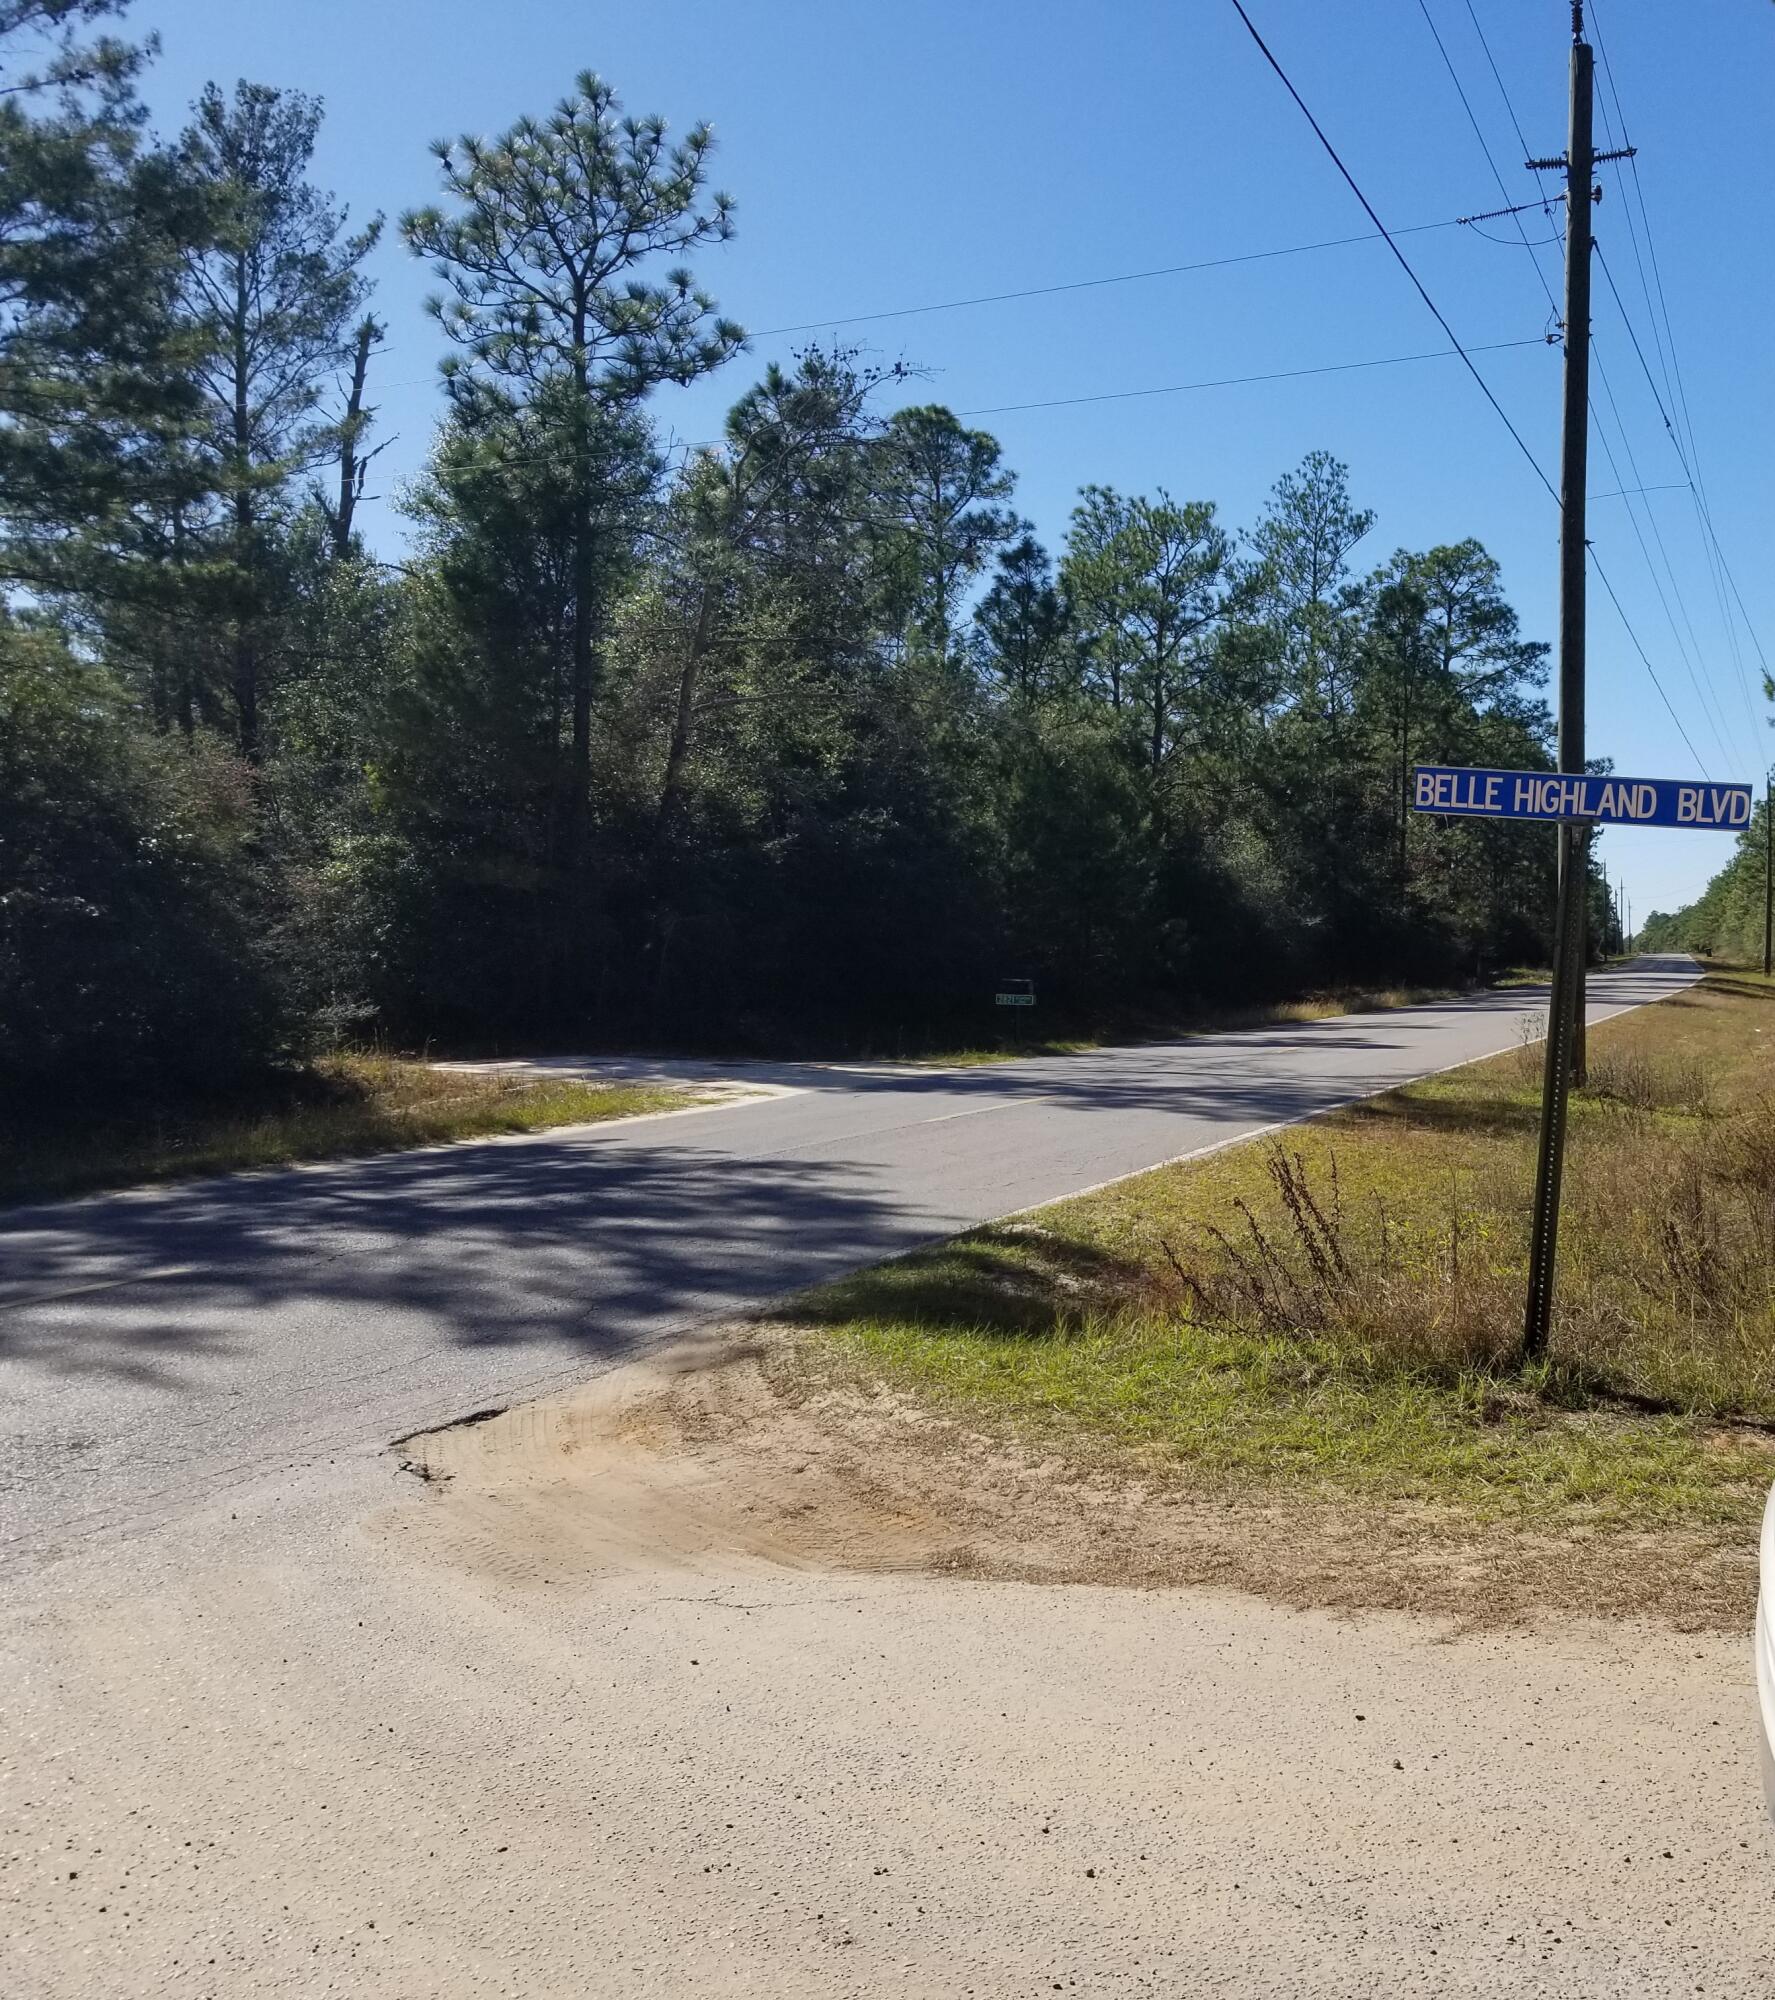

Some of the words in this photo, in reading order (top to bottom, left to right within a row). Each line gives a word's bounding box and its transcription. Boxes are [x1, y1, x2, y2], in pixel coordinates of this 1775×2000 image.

[1415, 773, 1503, 810] BELLE
[1513, 778, 1657, 818] HIGHLAND
[1676, 788, 1750, 825] BLVD
